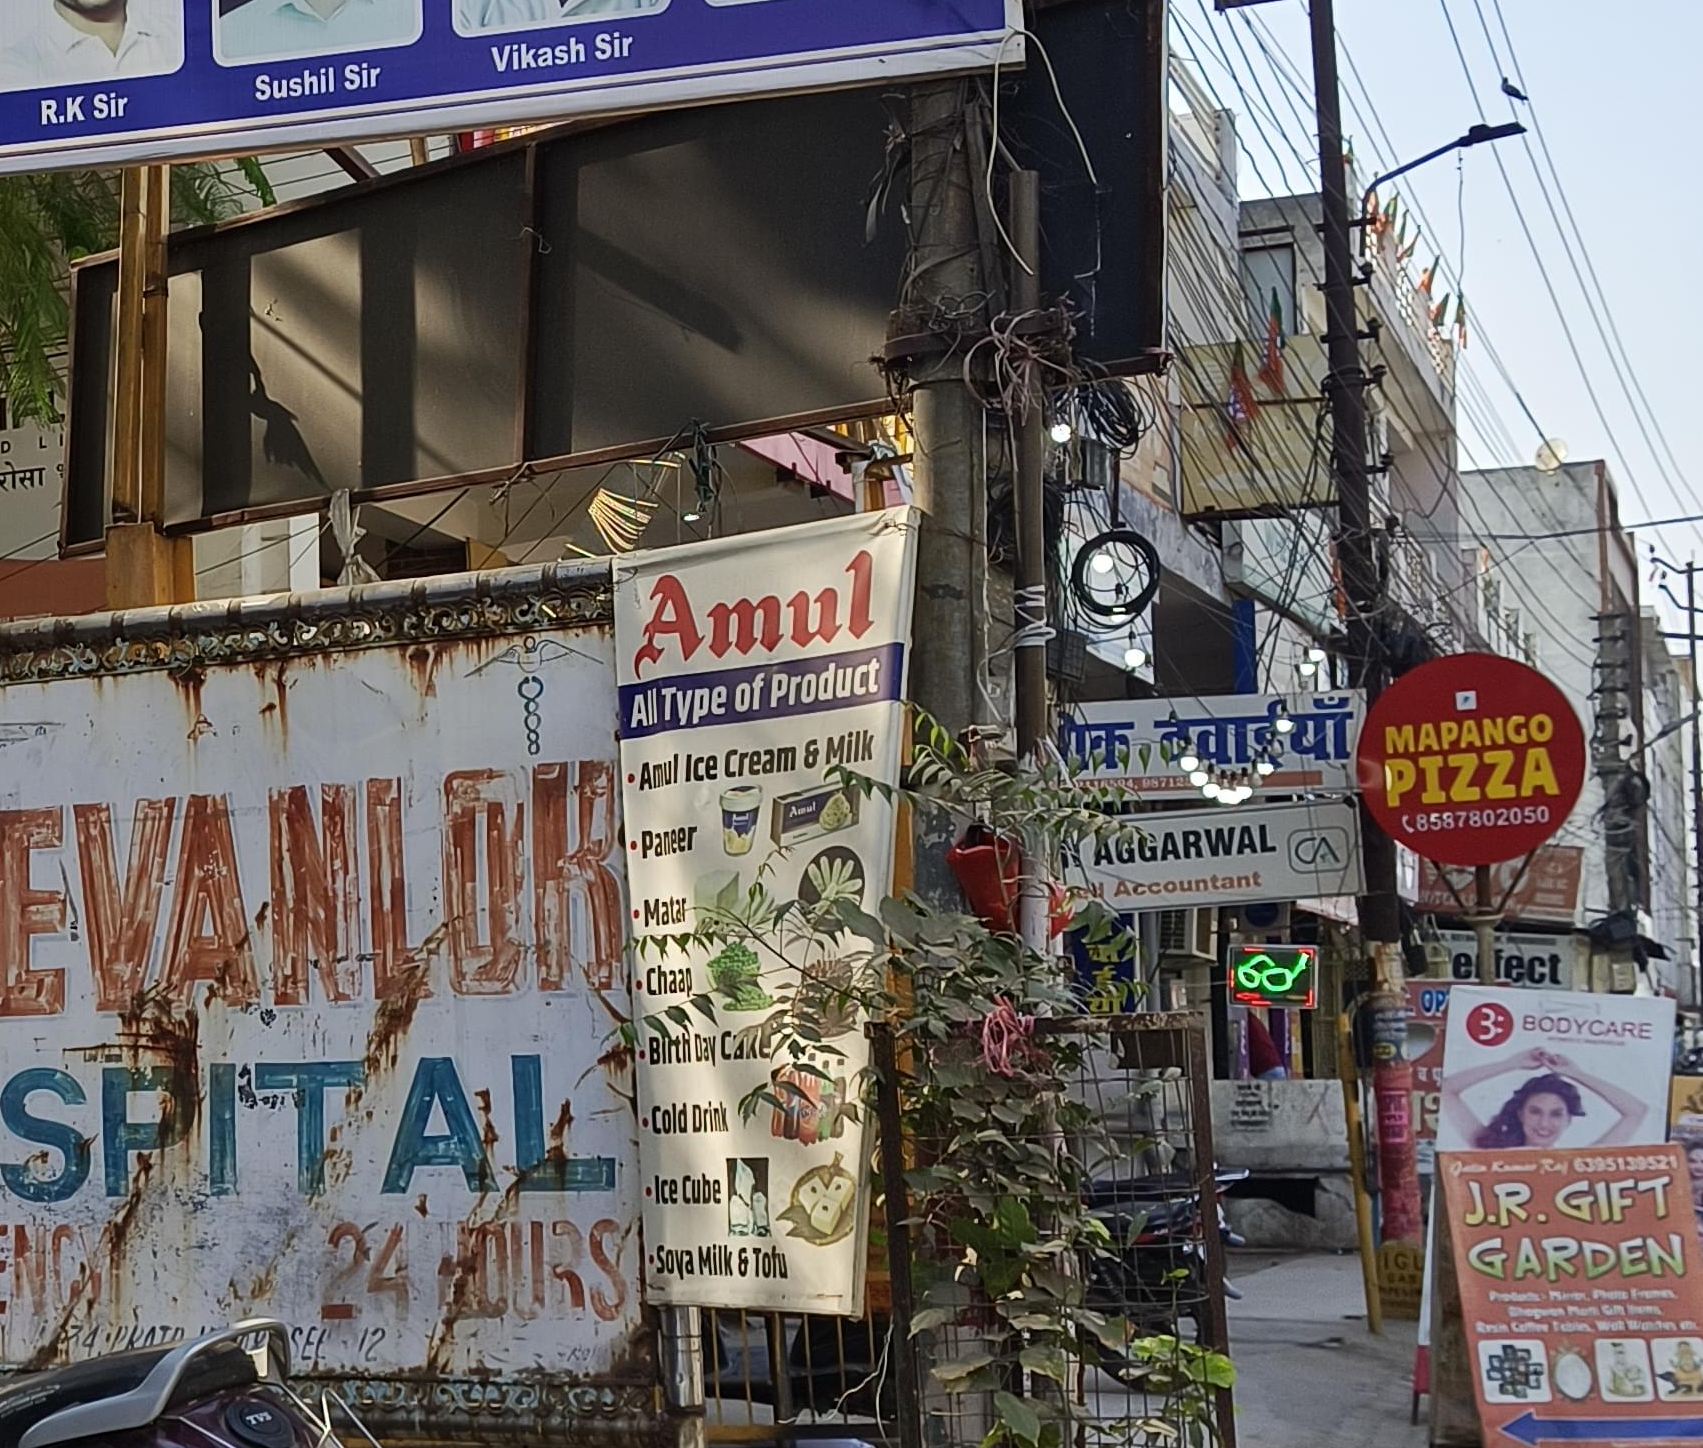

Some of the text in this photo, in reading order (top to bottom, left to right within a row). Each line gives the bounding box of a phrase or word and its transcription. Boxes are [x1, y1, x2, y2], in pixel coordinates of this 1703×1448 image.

[491, 33, 633, 72] Vikash Sir
[254, 62, 380, 101] Sushil Sir
[40, 92, 127, 125] R.K Sir
[634, 550, 875, 681] Amul
[631, 657, 880, 728] All Type of Product
[1385, 713, 1553, 753] MAPANGO
[639, 729, 875, 791] Amul Ice Cream & Milk
[1385, 747, 1561, 808] PIZZA
[1415, 806, 1550, 833] 8587802050
[641, 824, 697, 859] Paneer
[1094, 824, 1278, 867] AGGARWAL
[1114, 871, 1263, 898] Accountant
[644, 896, 686, 927] Matar
[646, 965, 694, 997] Chaap
[1522, 1015, 1654, 1040] BODYCARE
[695, 1033, 716, 1066] Day
[651, 1101, 729, 1135] Cold Drink
[654, 1174, 722, 1205] Ice Cube
[1554, 1176, 1671, 1223] GIFT
[321, 1222, 410, 1321] 24
[656, 1244, 788, 1280] Soya Milk & Tofu
[1467, 1233, 1685, 1281] GARDEN
